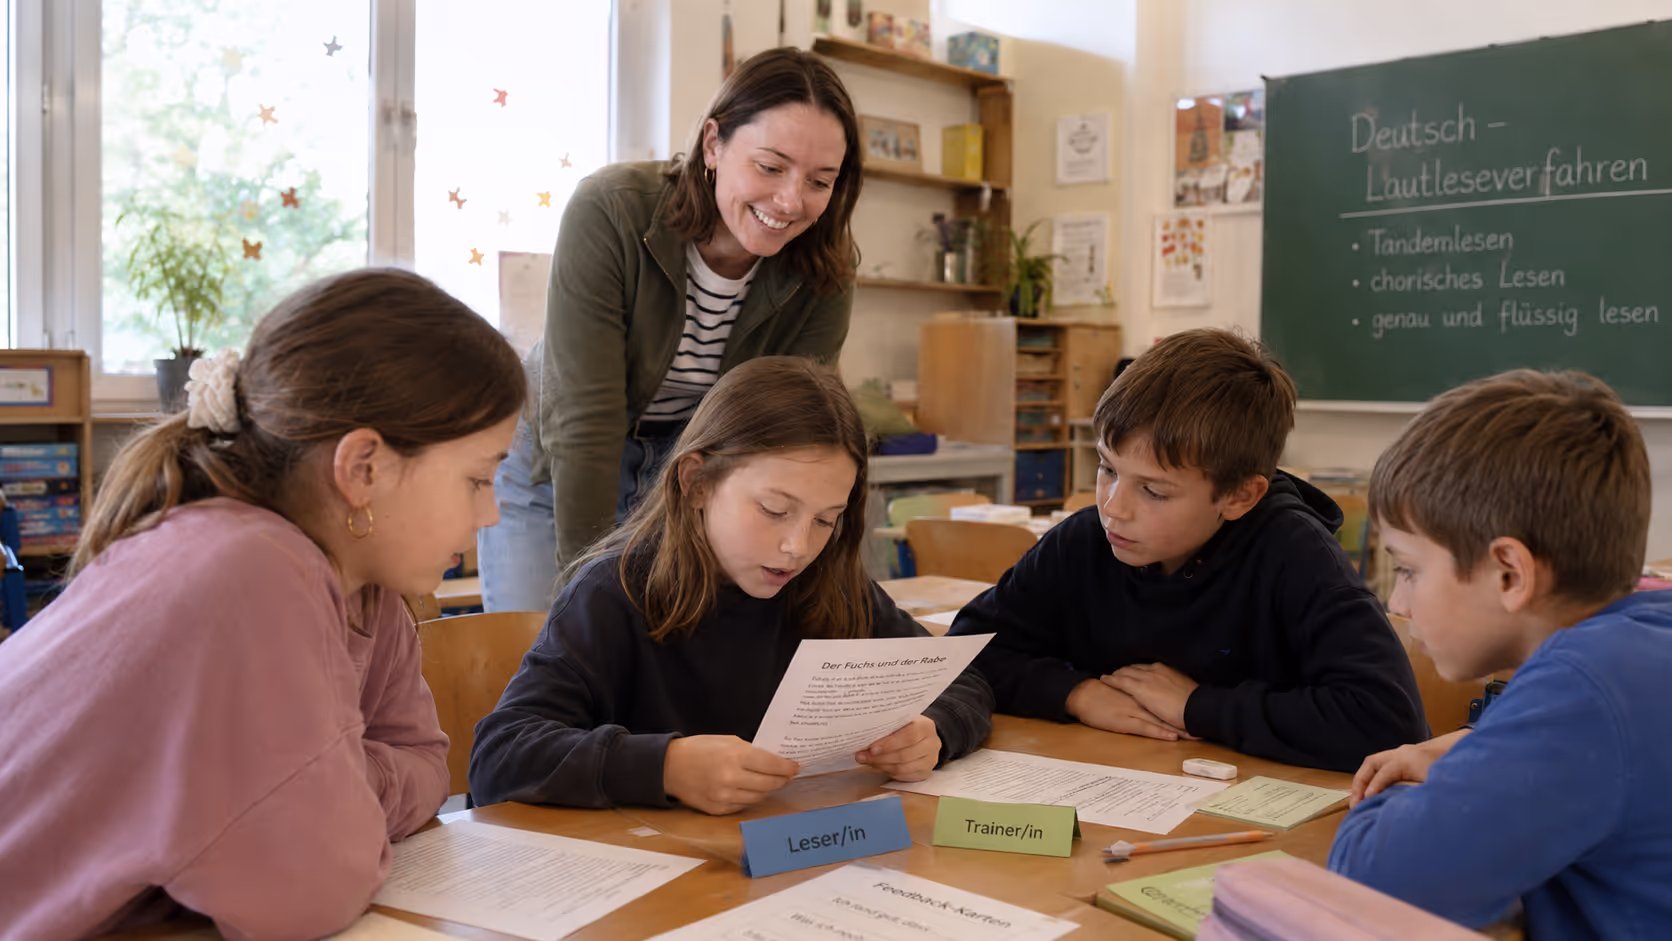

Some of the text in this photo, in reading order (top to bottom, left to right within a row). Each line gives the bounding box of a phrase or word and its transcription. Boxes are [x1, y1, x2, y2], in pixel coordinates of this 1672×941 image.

[1351, 101, 1476, 153] Deutsch
[1366, 146, 1648, 202] Lautleseverfahren
[1367, 223, 1514, 256] Tandemlesen
[1370, 257, 1566, 292] chorisches Lesen
[1372, 295, 1659, 339] genau und flüssig lesen
[821, 656, 947, 670] Der Fuchs und der Rabe
[787, 825, 866, 853] Leser/in
[965, 819, 1043, 841] Trainer/in
[872, 881, 1011, 929] Feedback-Karten
